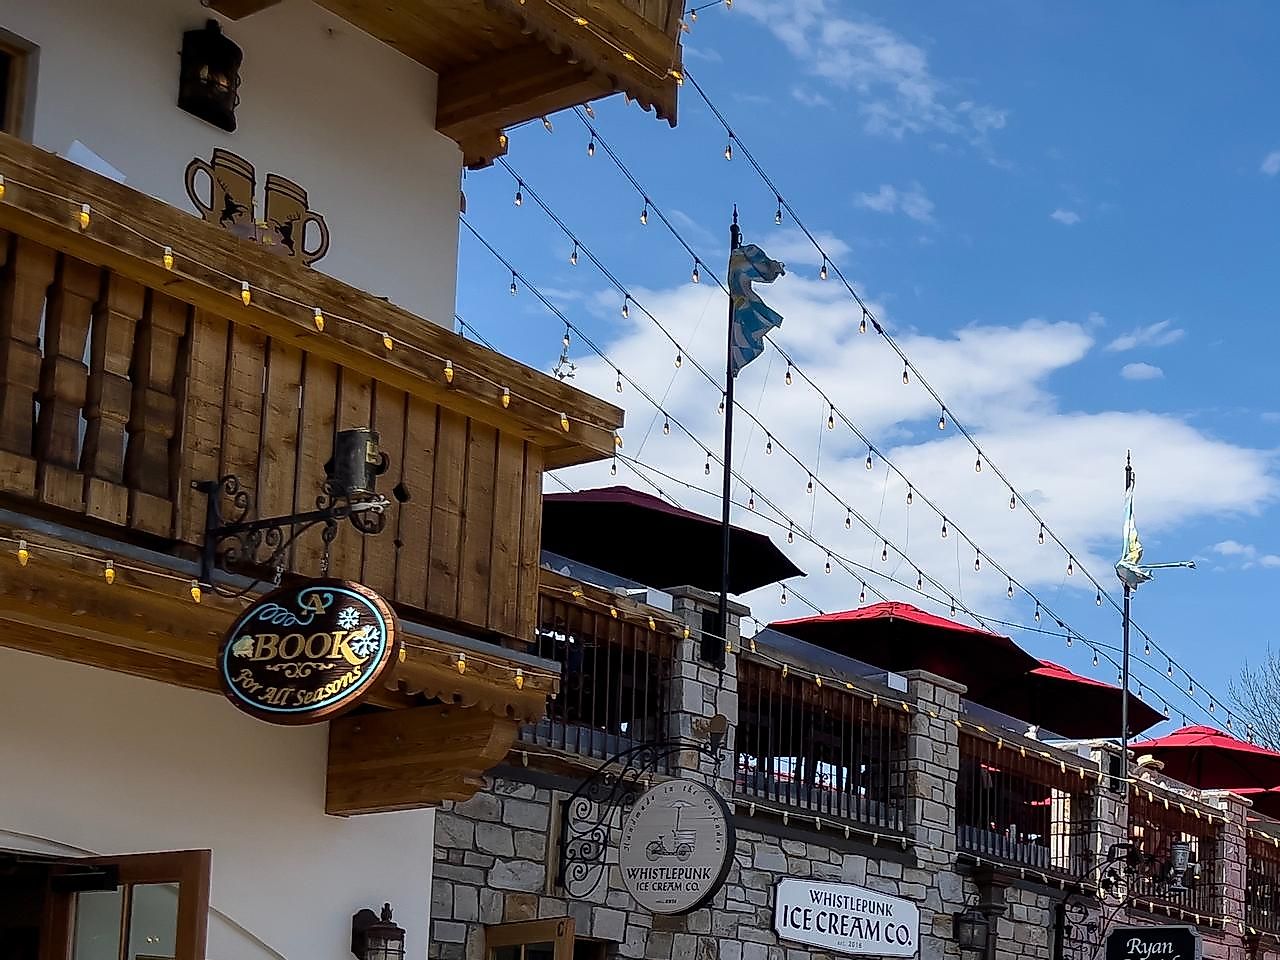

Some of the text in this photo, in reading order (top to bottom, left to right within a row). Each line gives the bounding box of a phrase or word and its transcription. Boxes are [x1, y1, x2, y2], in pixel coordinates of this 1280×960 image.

[302, 593, 326, 615] A
[249, 630, 370, 665] BOOK
[232, 665, 363, 706] For All Seasons
[626, 867, 712, 880] WHISTLEPUNK
[636, 882, 649, 891] ICE
[652, 882, 682, 891] CREAM
[809, 889, 893, 917] WHISTLEPUNK
[783, 905, 912, 946] ICE CREAM CO.
[1126, 938, 1174, 960] Ryan
